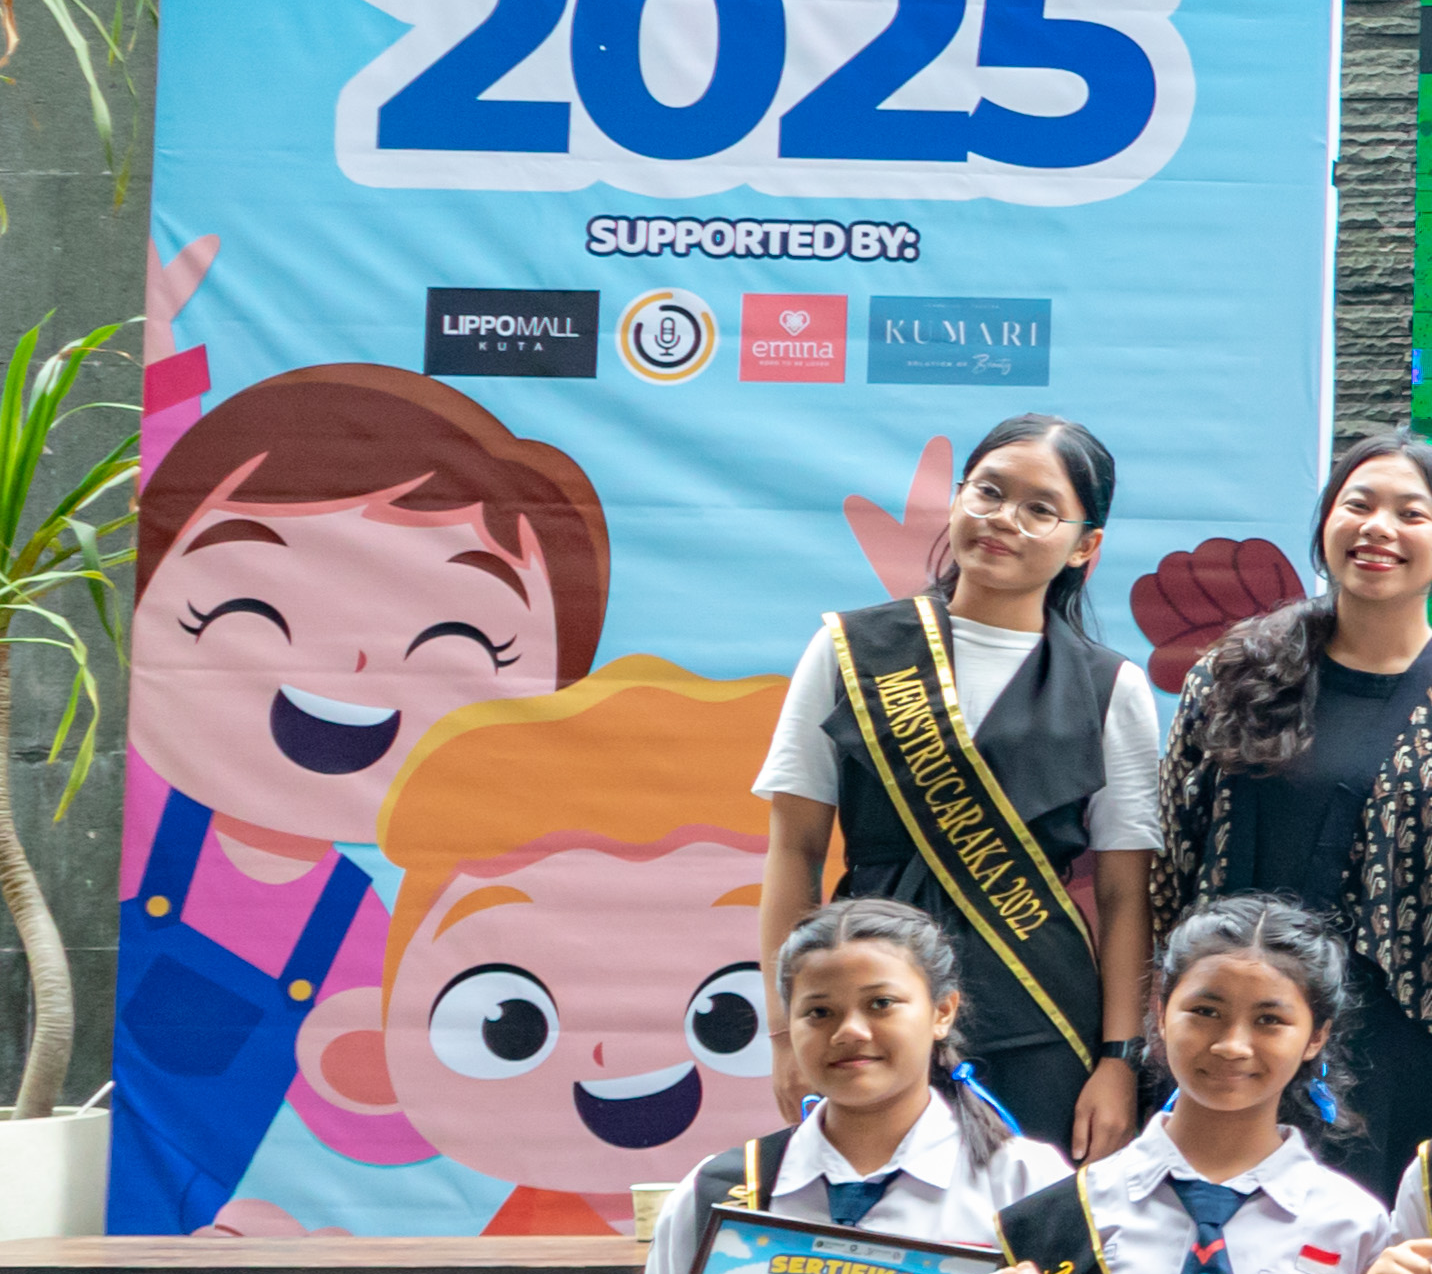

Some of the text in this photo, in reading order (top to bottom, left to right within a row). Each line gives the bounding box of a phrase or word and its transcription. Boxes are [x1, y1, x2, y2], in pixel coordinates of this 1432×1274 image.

[587, 216, 920, 261] SUPPORTED BY:
[479, 341, 545, 352] KUTA
[886, 319, 1038, 347] KUMARI
[753, 338, 834, 359] emina
[875, 666, 1050, 941] MENSTRUCARAKA 2022
